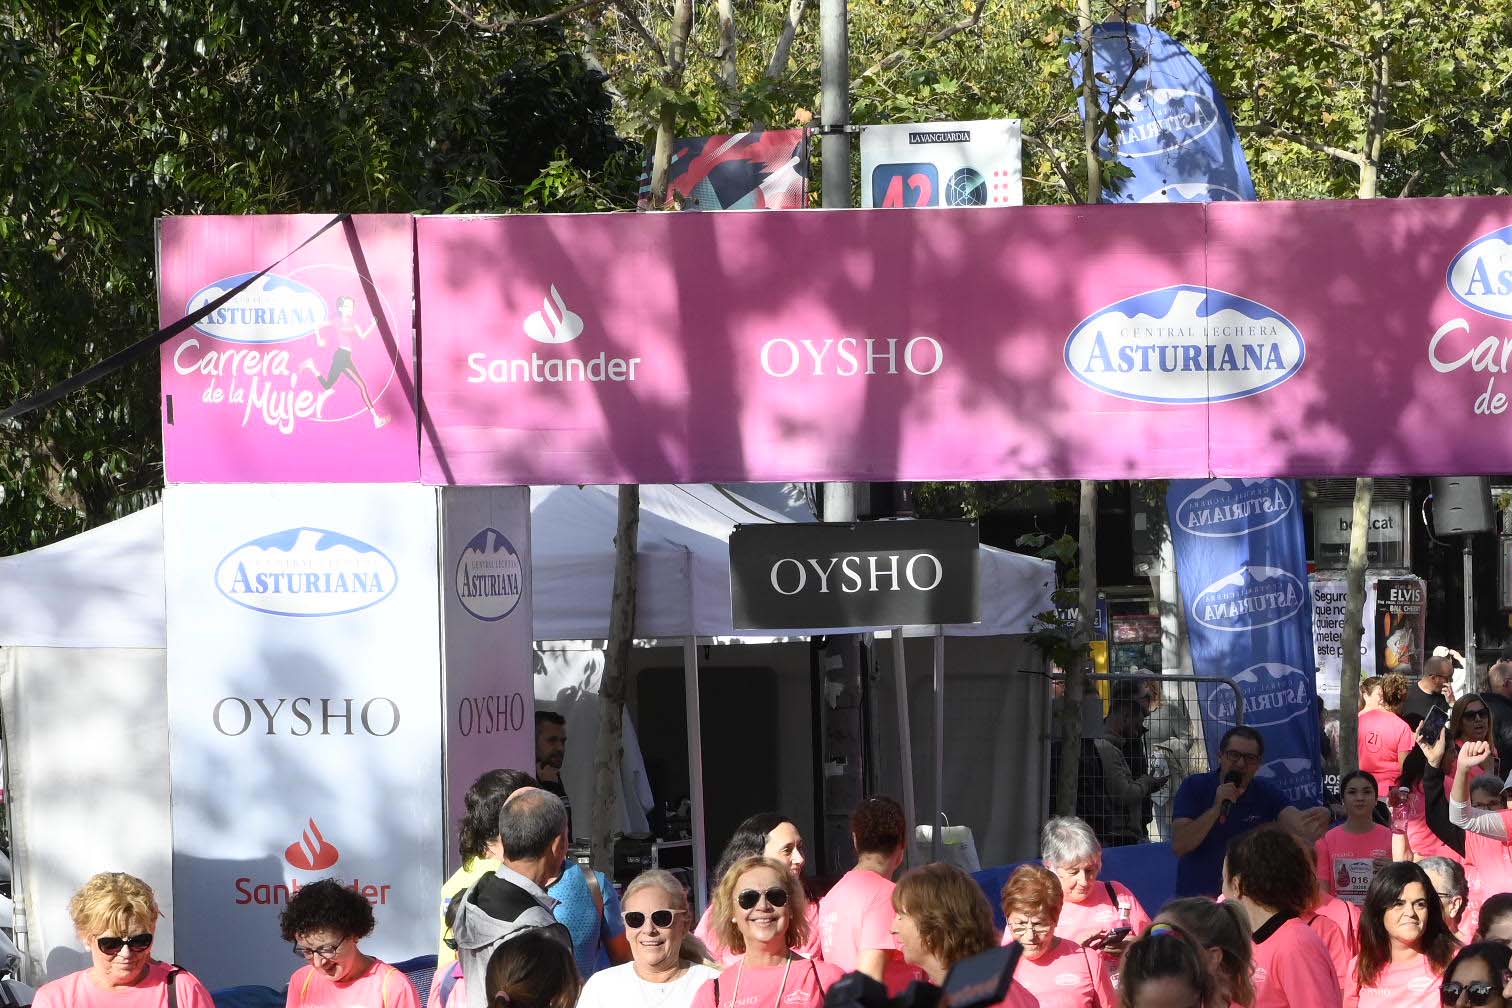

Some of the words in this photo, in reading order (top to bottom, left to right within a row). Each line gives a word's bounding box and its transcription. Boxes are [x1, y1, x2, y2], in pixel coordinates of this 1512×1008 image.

[922, 131, 970, 143] VANGUARDIA
[1120, 326, 1196, 338] CENTRAL
[1203, 325, 1278, 337] LECHERA
[173, 338, 291, 376] Carrera
[467, 351, 641, 383] Santander
[760, 336, 944, 378] OYSHO
[1083, 330, 1286, 374] ASTURIANA
[202, 378, 224, 404] de
[229, 376, 244, 404] la
[242, 371, 335, 434] Mujer
[1473, 376, 1508, 415] de
[230, 560, 384, 595] ASTURIANA
[461, 569, 519, 598] ASTURIANA
[770, 553, 944, 596] OYSHO
[1390, 588, 1420, 601] ELVIS
[1316, 619, 1345, 632] quiere
[212, 696, 401, 737] OYSHO
[458, 692, 525, 737] OYSHO
